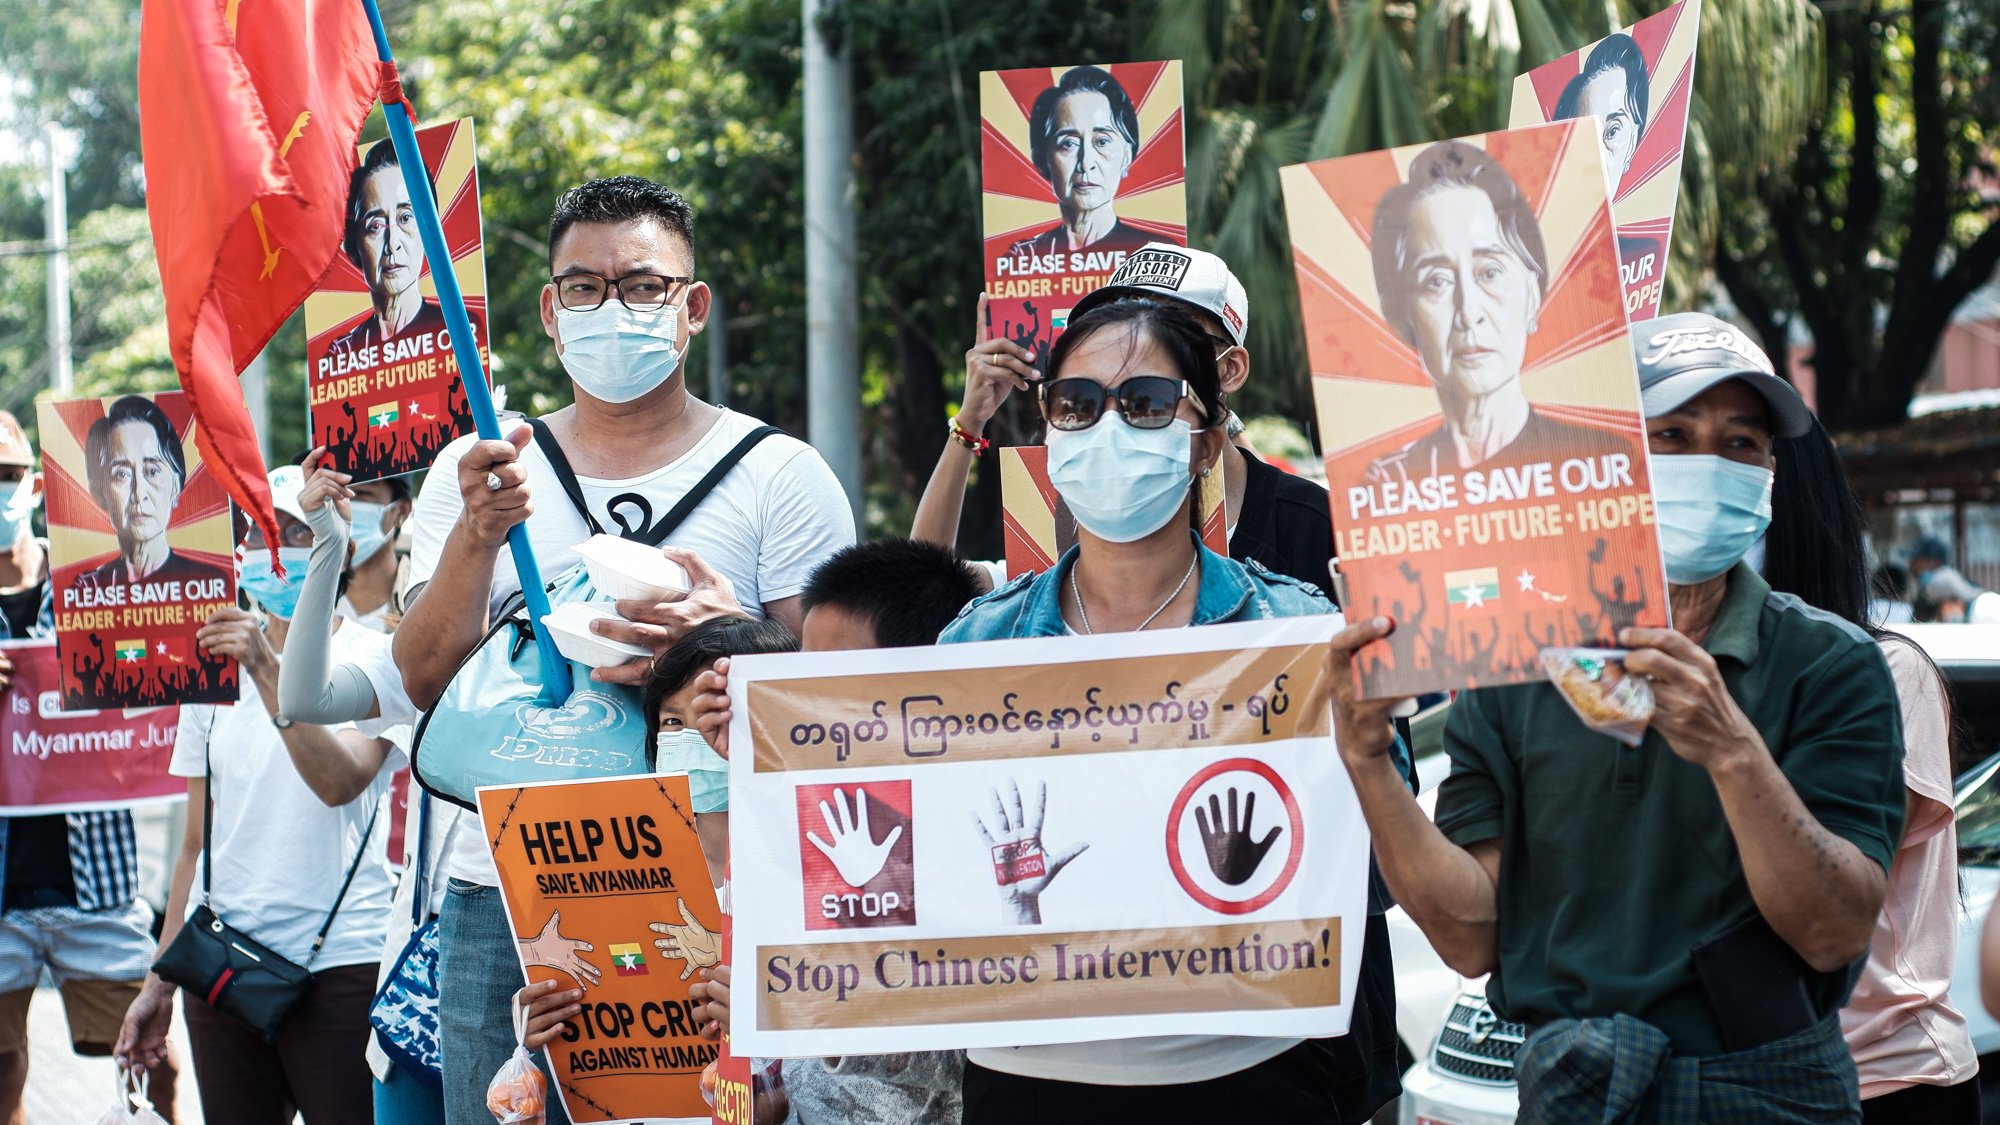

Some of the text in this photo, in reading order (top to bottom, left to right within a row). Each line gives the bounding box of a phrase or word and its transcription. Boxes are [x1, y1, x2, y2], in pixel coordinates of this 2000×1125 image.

[996, 250, 1127, 277] PLEASE SAVE
[1125, 253, 1183, 267] ARENTAL
[985, 273, 1112, 300] LEADER FUTU
[1138, 275, 1177, 286] CONTENT
[1625, 280, 1660, 314] OPE
[318, 323, 478, 380] PLEASE SAVE OR
[310, 345, 489, 406] LEADER FUTURE HE
[1348, 454, 1633, 520] PLEASE SAVE OUR
[1336, 493, 1655, 561] LEADER FUTURE HOPE
[63, 578, 226, 609] PLEASE SAVE OUR
[54, 610, 115, 632] LEADER
[123, 605, 184, 627] FUTURE
[12, 694, 31, 715] Is
[790, 700, 889, 762] တရုတ်
[1246, 673, 1289, 735] ရပ်
[12, 728, 136, 760] Myanmar
[519, 814, 663, 865] HELP US
[536, 867, 675, 895] SAVE MYANMAR
[822, 891, 900, 921] STOP
[766, 929, 1333, 1002] Stop Chinese Intervention!
[569, 1047, 647, 1074] AGAINST
